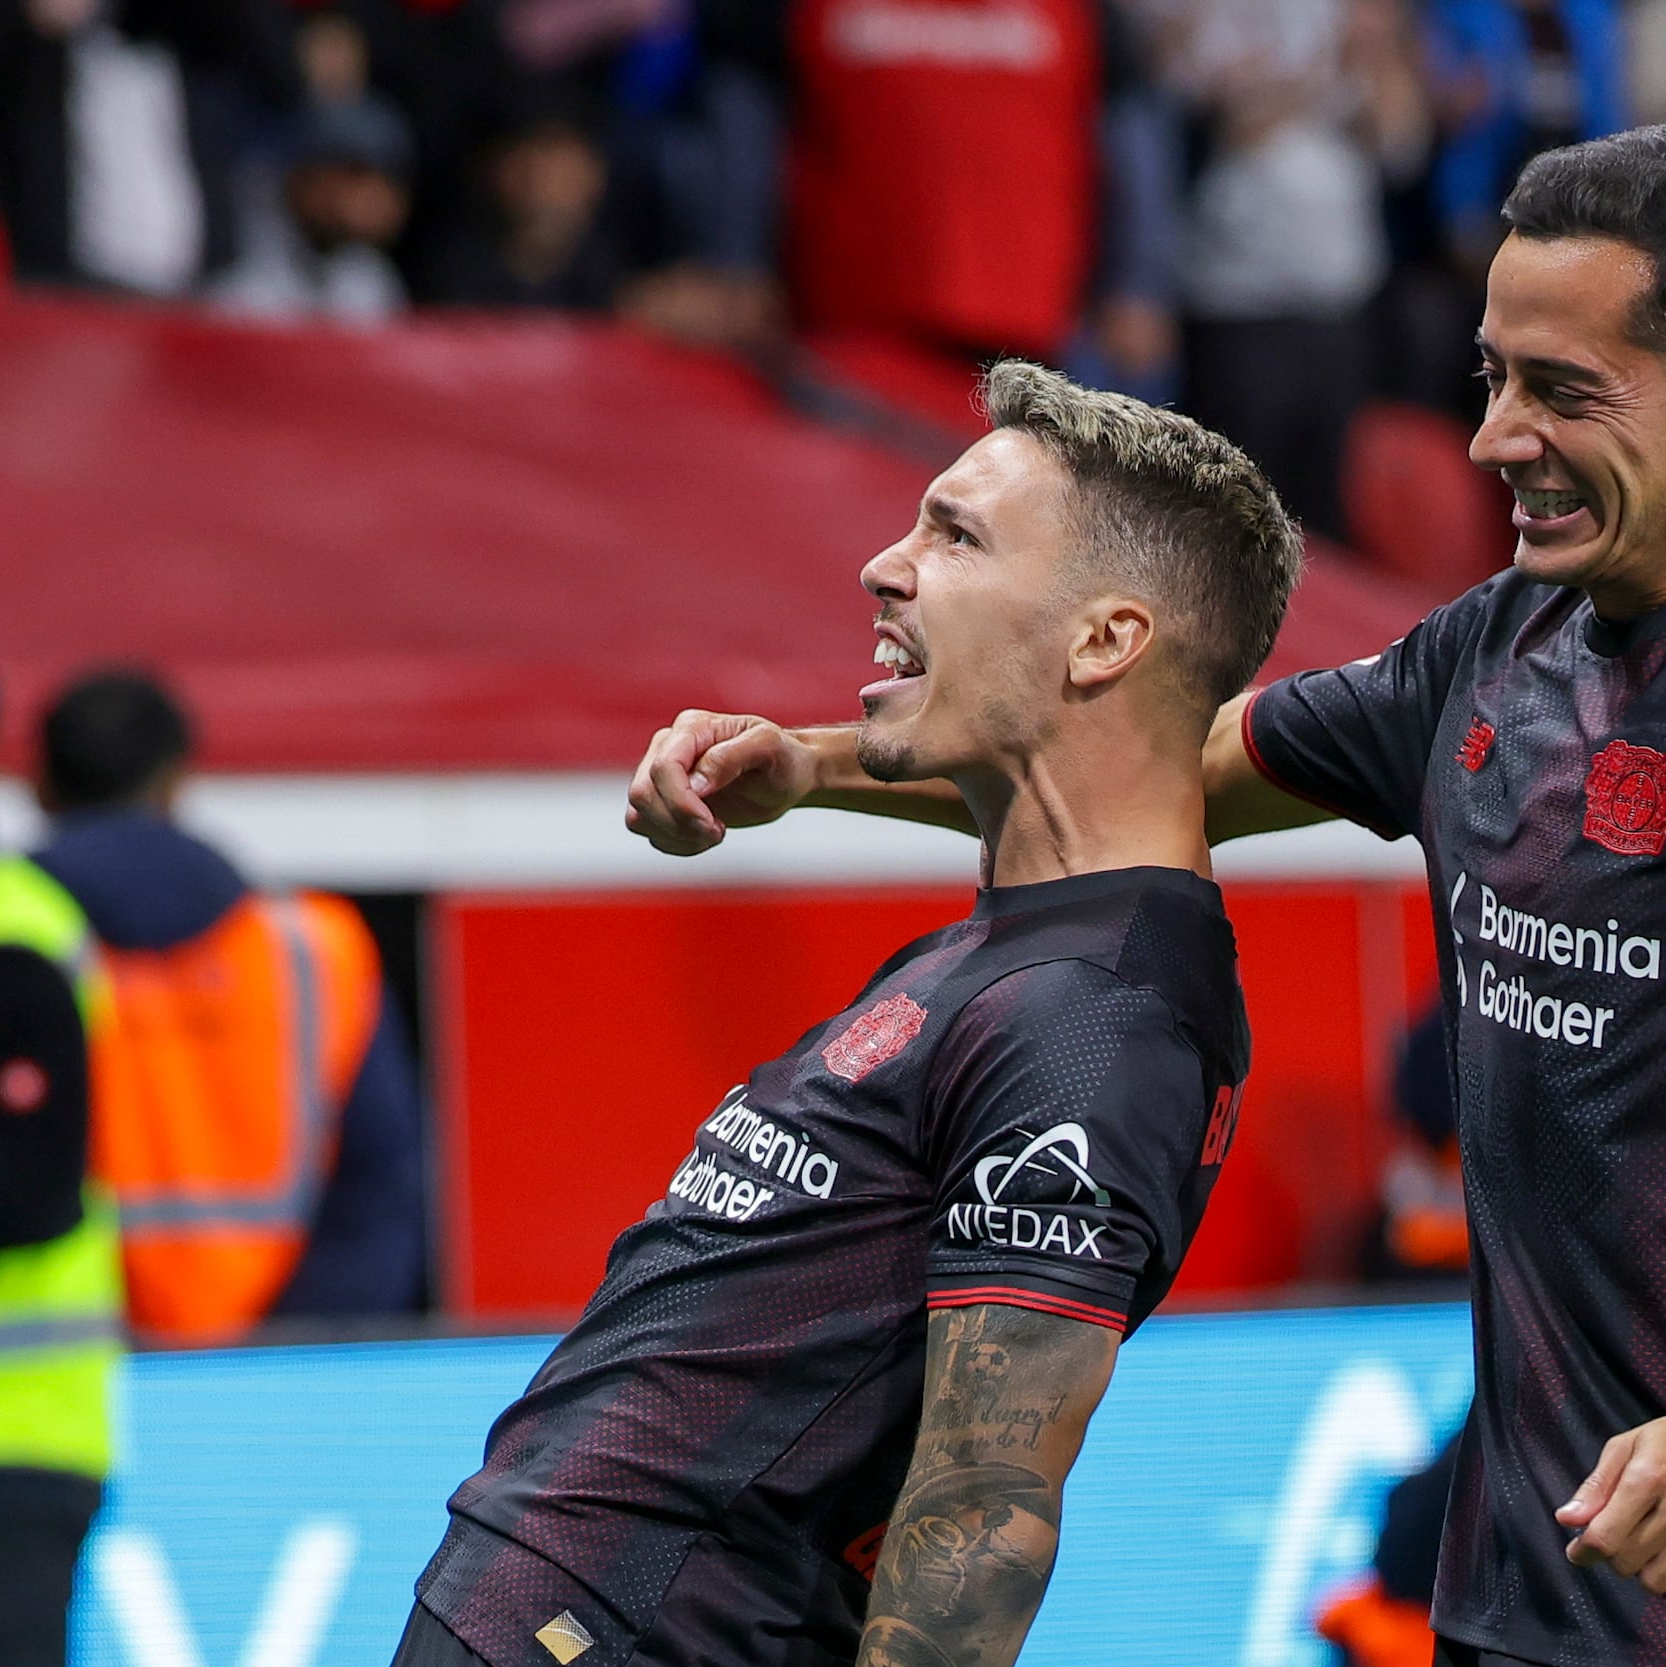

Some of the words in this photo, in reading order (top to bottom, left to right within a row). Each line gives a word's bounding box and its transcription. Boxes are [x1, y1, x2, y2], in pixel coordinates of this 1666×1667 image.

[1479, 884, 1661, 979] Barmenia
[1478, 960, 1615, 1048] Gothaer
[948, 1203, 1108, 1260] NIEDAX
